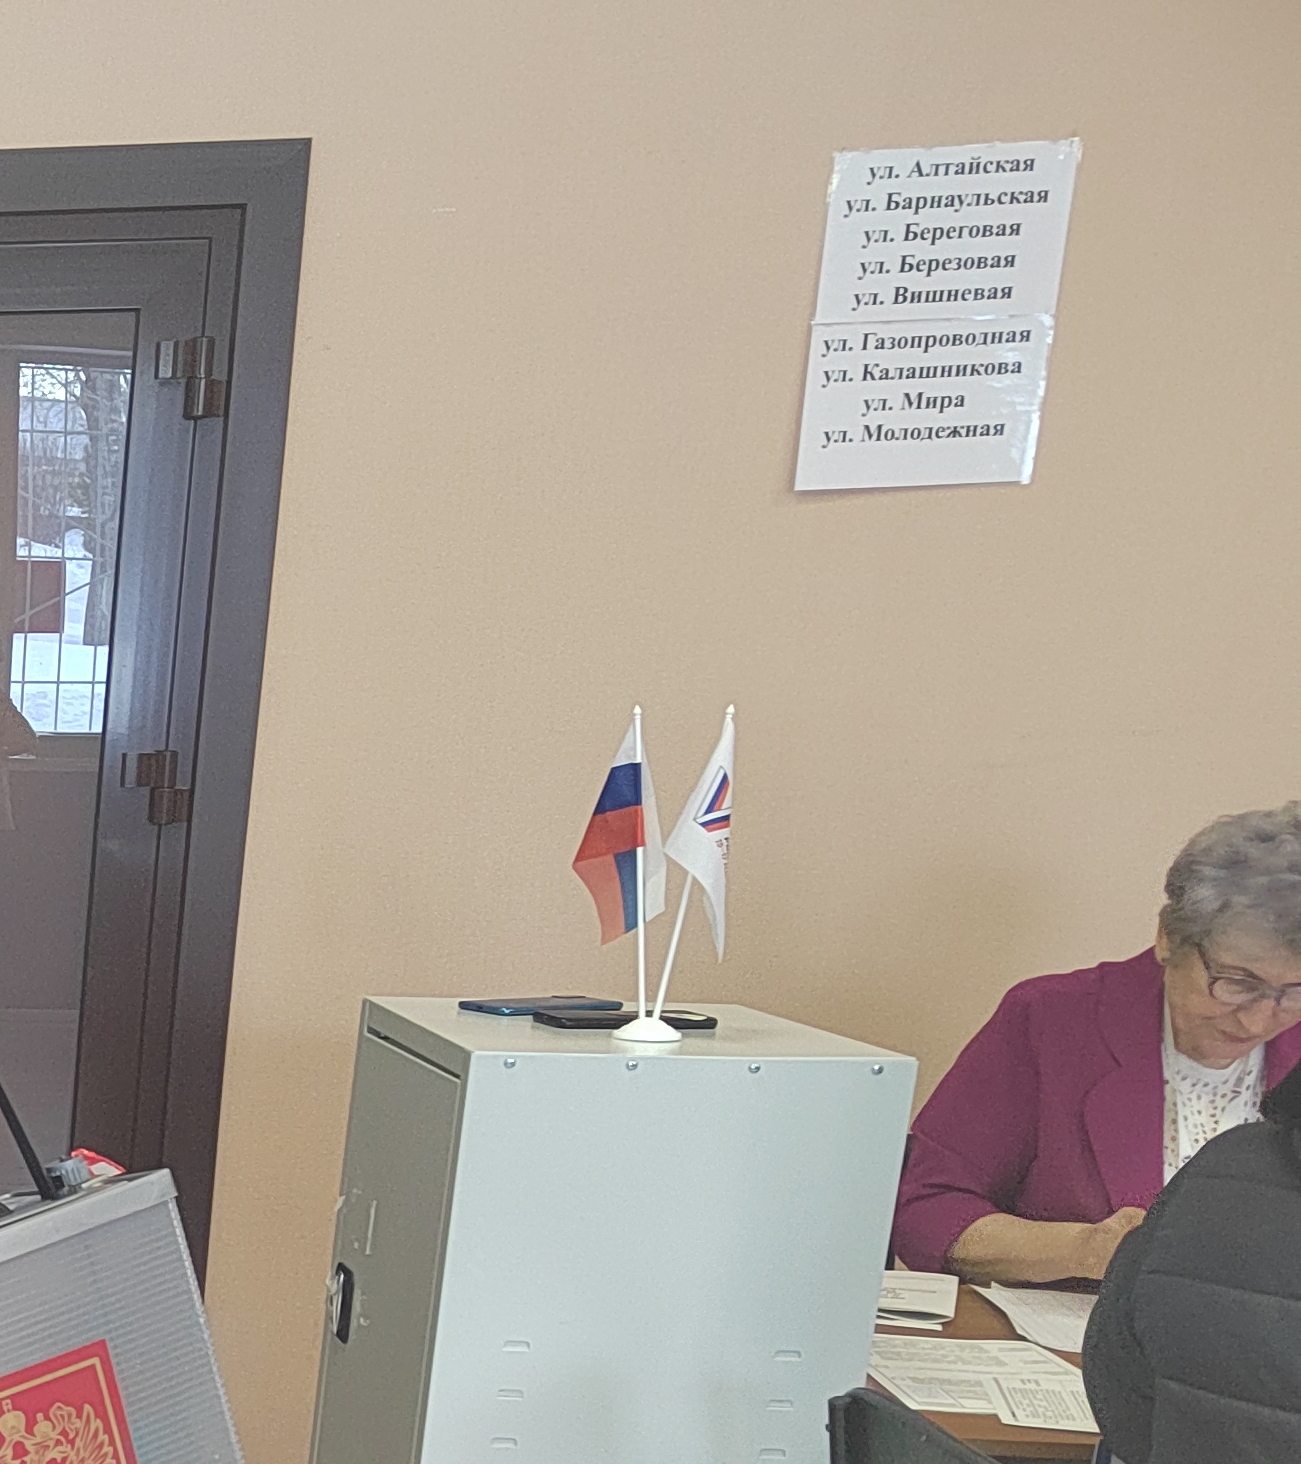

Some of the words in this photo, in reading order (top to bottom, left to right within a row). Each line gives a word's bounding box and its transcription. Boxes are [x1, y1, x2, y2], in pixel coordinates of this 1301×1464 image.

[866, 165, 900, 185] ул.
[905, 156, 1036, 179] Алтайская
[843, 198, 877, 218] ул.
[885, 189, 1050, 215] Барнаульская
[861, 229, 895, 249] ул.
[903, 222, 1023, 246] Береговая
[857, 260, 891, 280] ул.
[898, 253, 1017, 277] Березовая
[851, 292, 885, 311] ул.
[891, 285, 1013, 305] Вишневая
[821, 338, 854, 357] ул.
[860, 329, 1032, 353] Газопроводная
[821, 369, 854, 388] ул.
[860, 360, 1023, 382] Калашникова
[861, 398, 894, 417] ул.
[899, 391, 966, 414] Мира
[821, 430, 854, 449] ул.
[859, 422, 1006, 444] Молодежная
